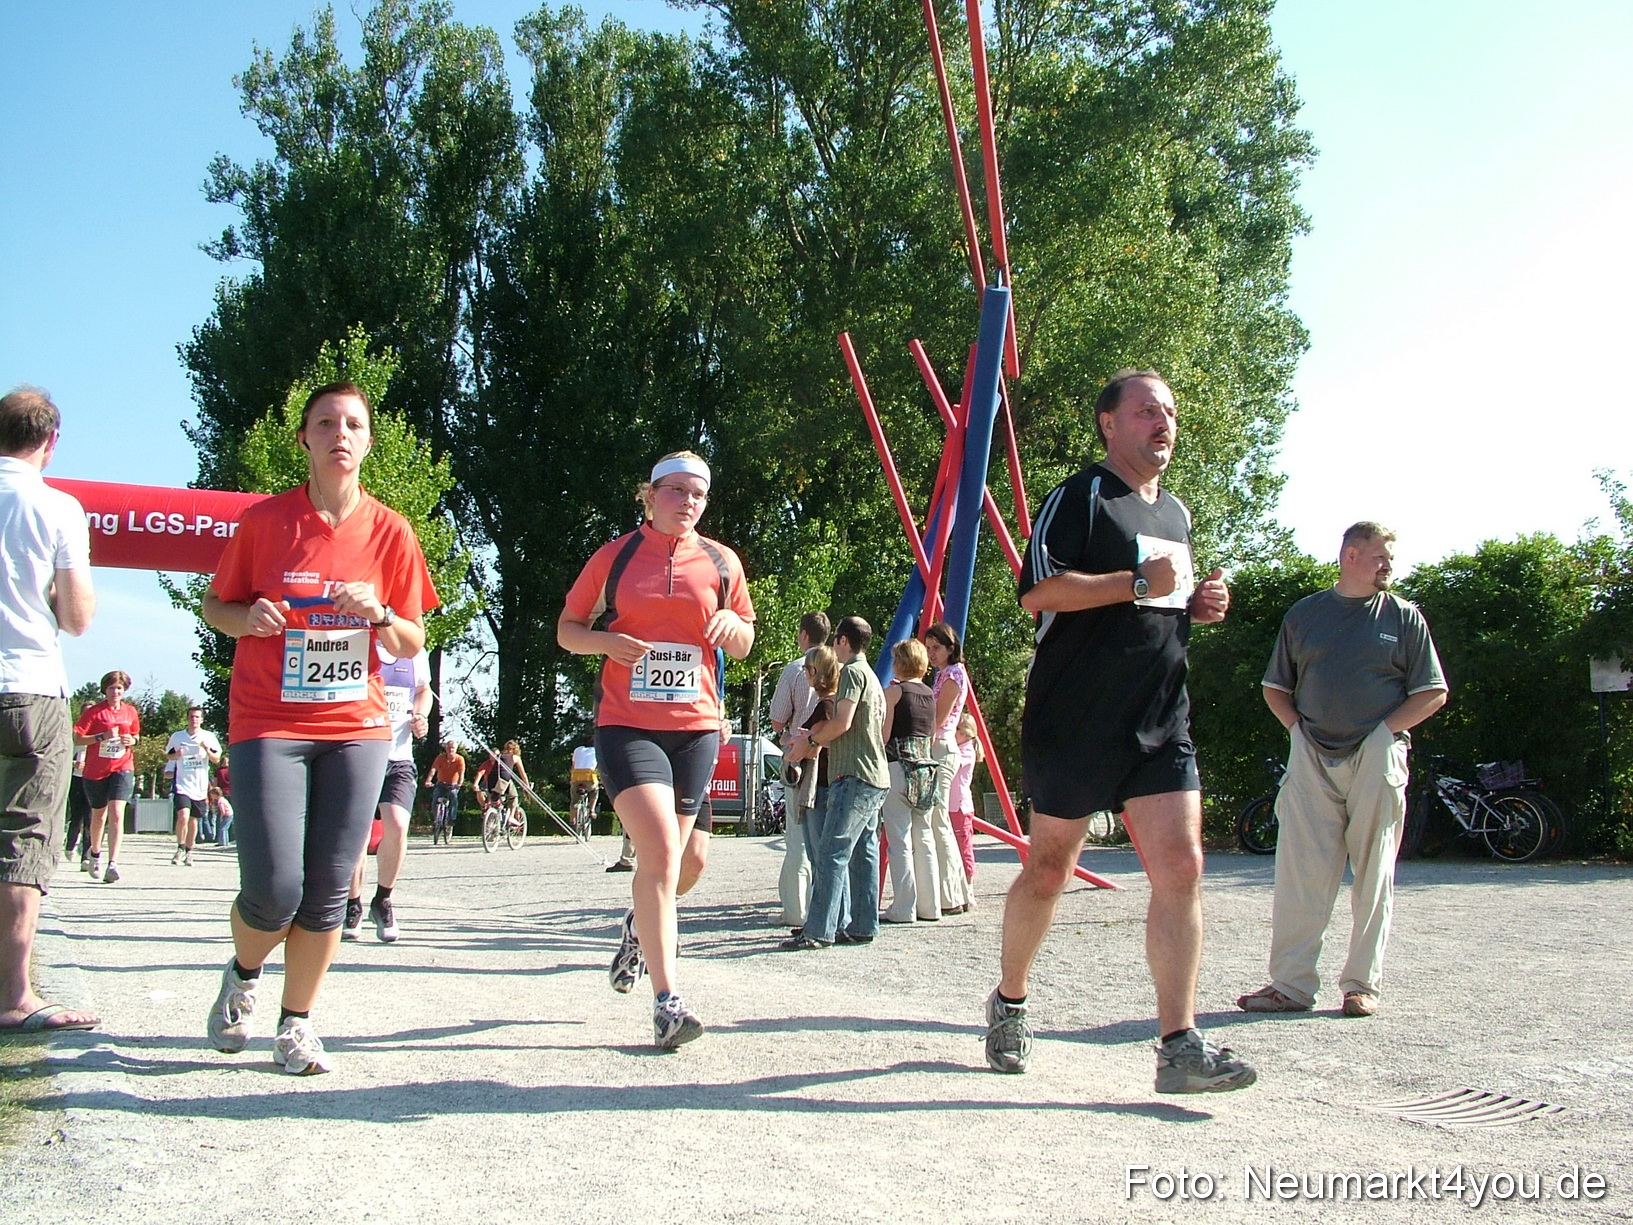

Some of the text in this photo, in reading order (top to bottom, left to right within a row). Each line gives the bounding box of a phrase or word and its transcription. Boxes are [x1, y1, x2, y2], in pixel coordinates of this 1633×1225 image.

[306, 638, 349, 652] Andrea
[288, 656, 298, 668] C
[649, 650, 692, 662] Susi-Bär
[306, 660, 362, 683] 2456
[635, 665, 643, 675] C
[650, 669, 695, 687] 2021
